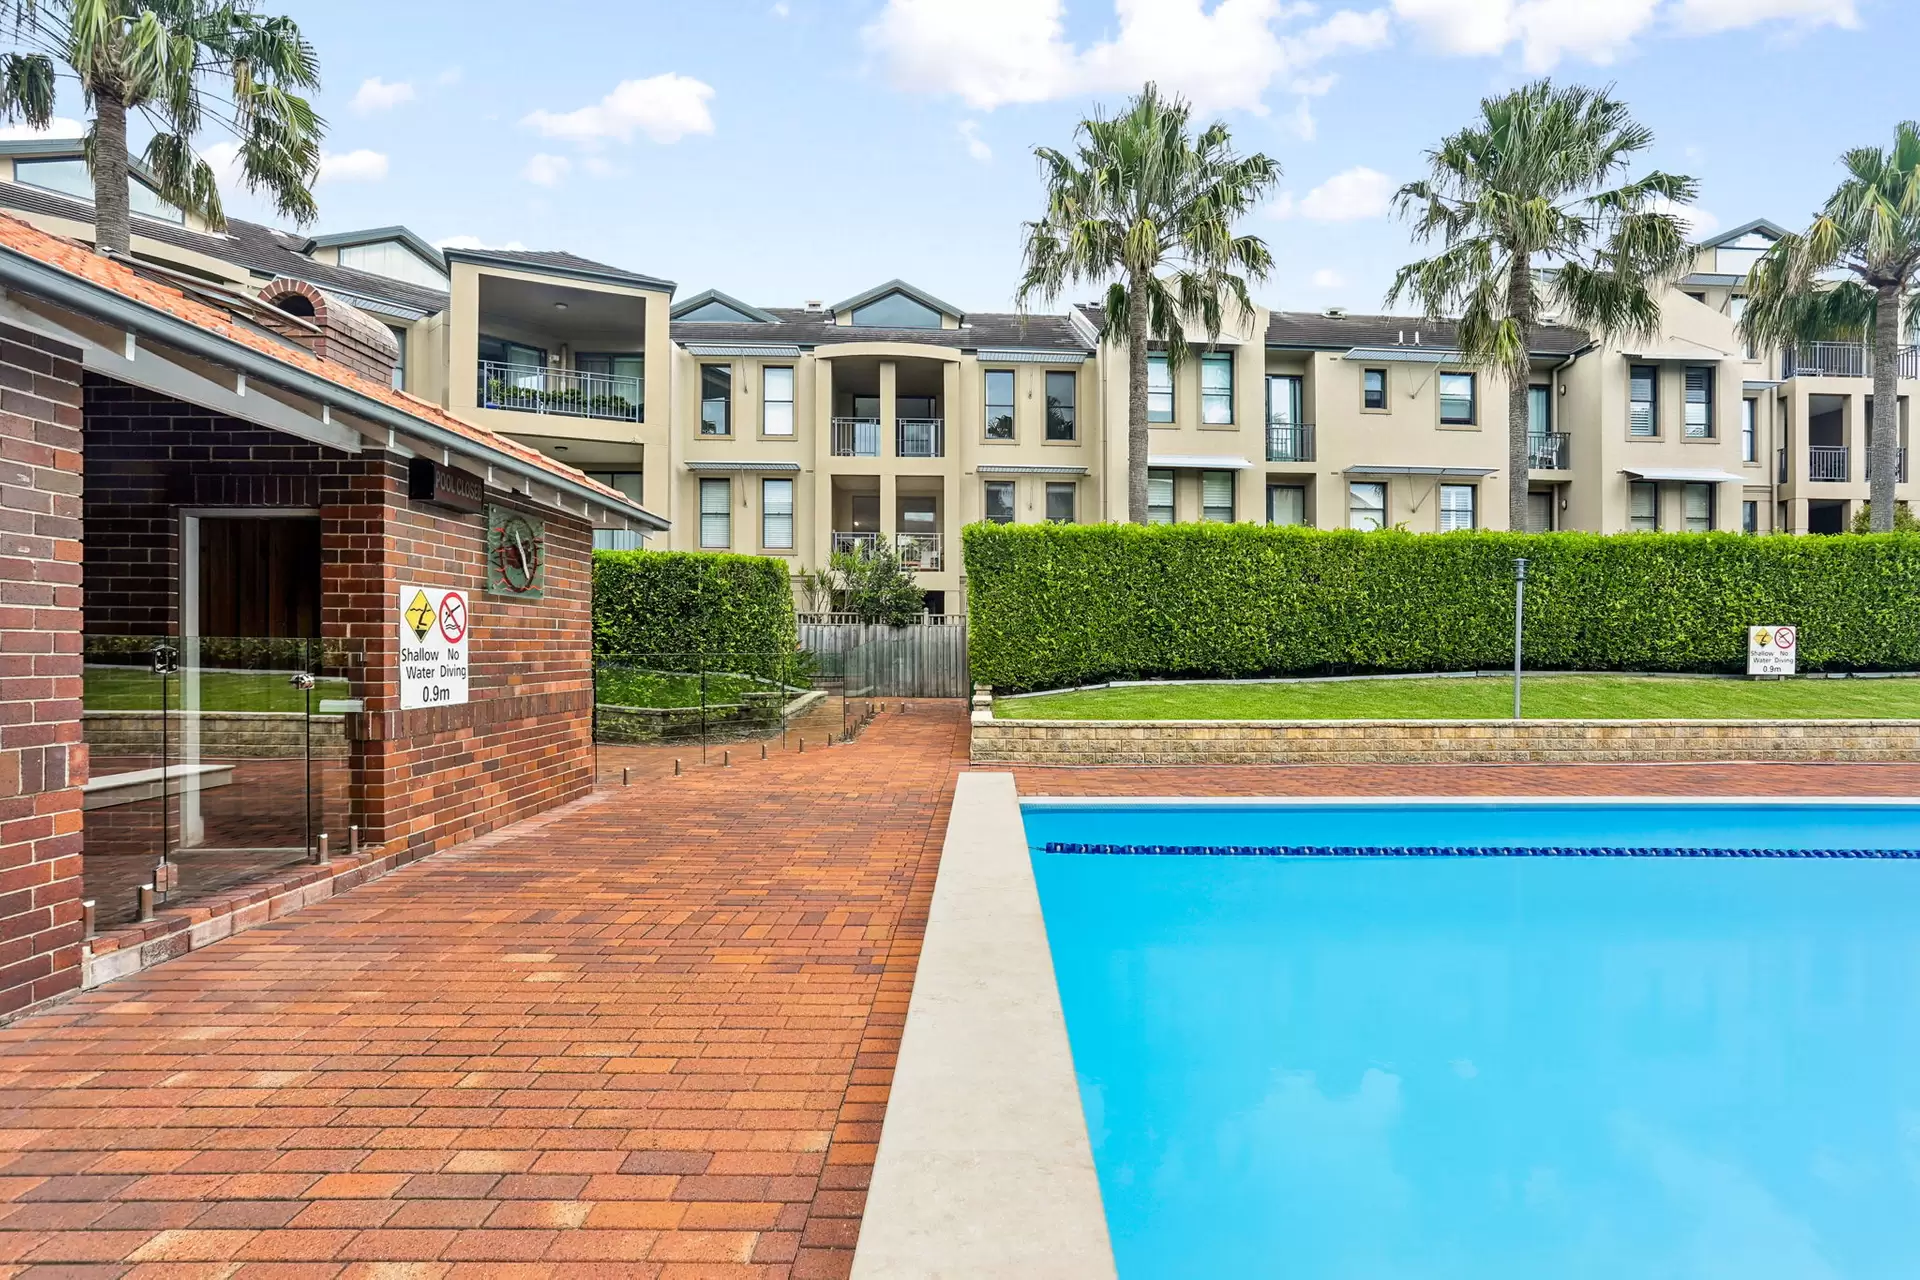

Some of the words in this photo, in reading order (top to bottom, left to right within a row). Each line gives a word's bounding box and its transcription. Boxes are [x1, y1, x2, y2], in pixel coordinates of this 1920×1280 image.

[435, 470, 456, 493] POOL
[456, 478, 483, 501] CLOSED
[401, 648, 439, 662] Shallow
[447, 648, 460, 661] No
[406, 666, 435, 679] Water
[440, 664, 466, 679] Diving
[422, 685, 450, 703] 0.9m
